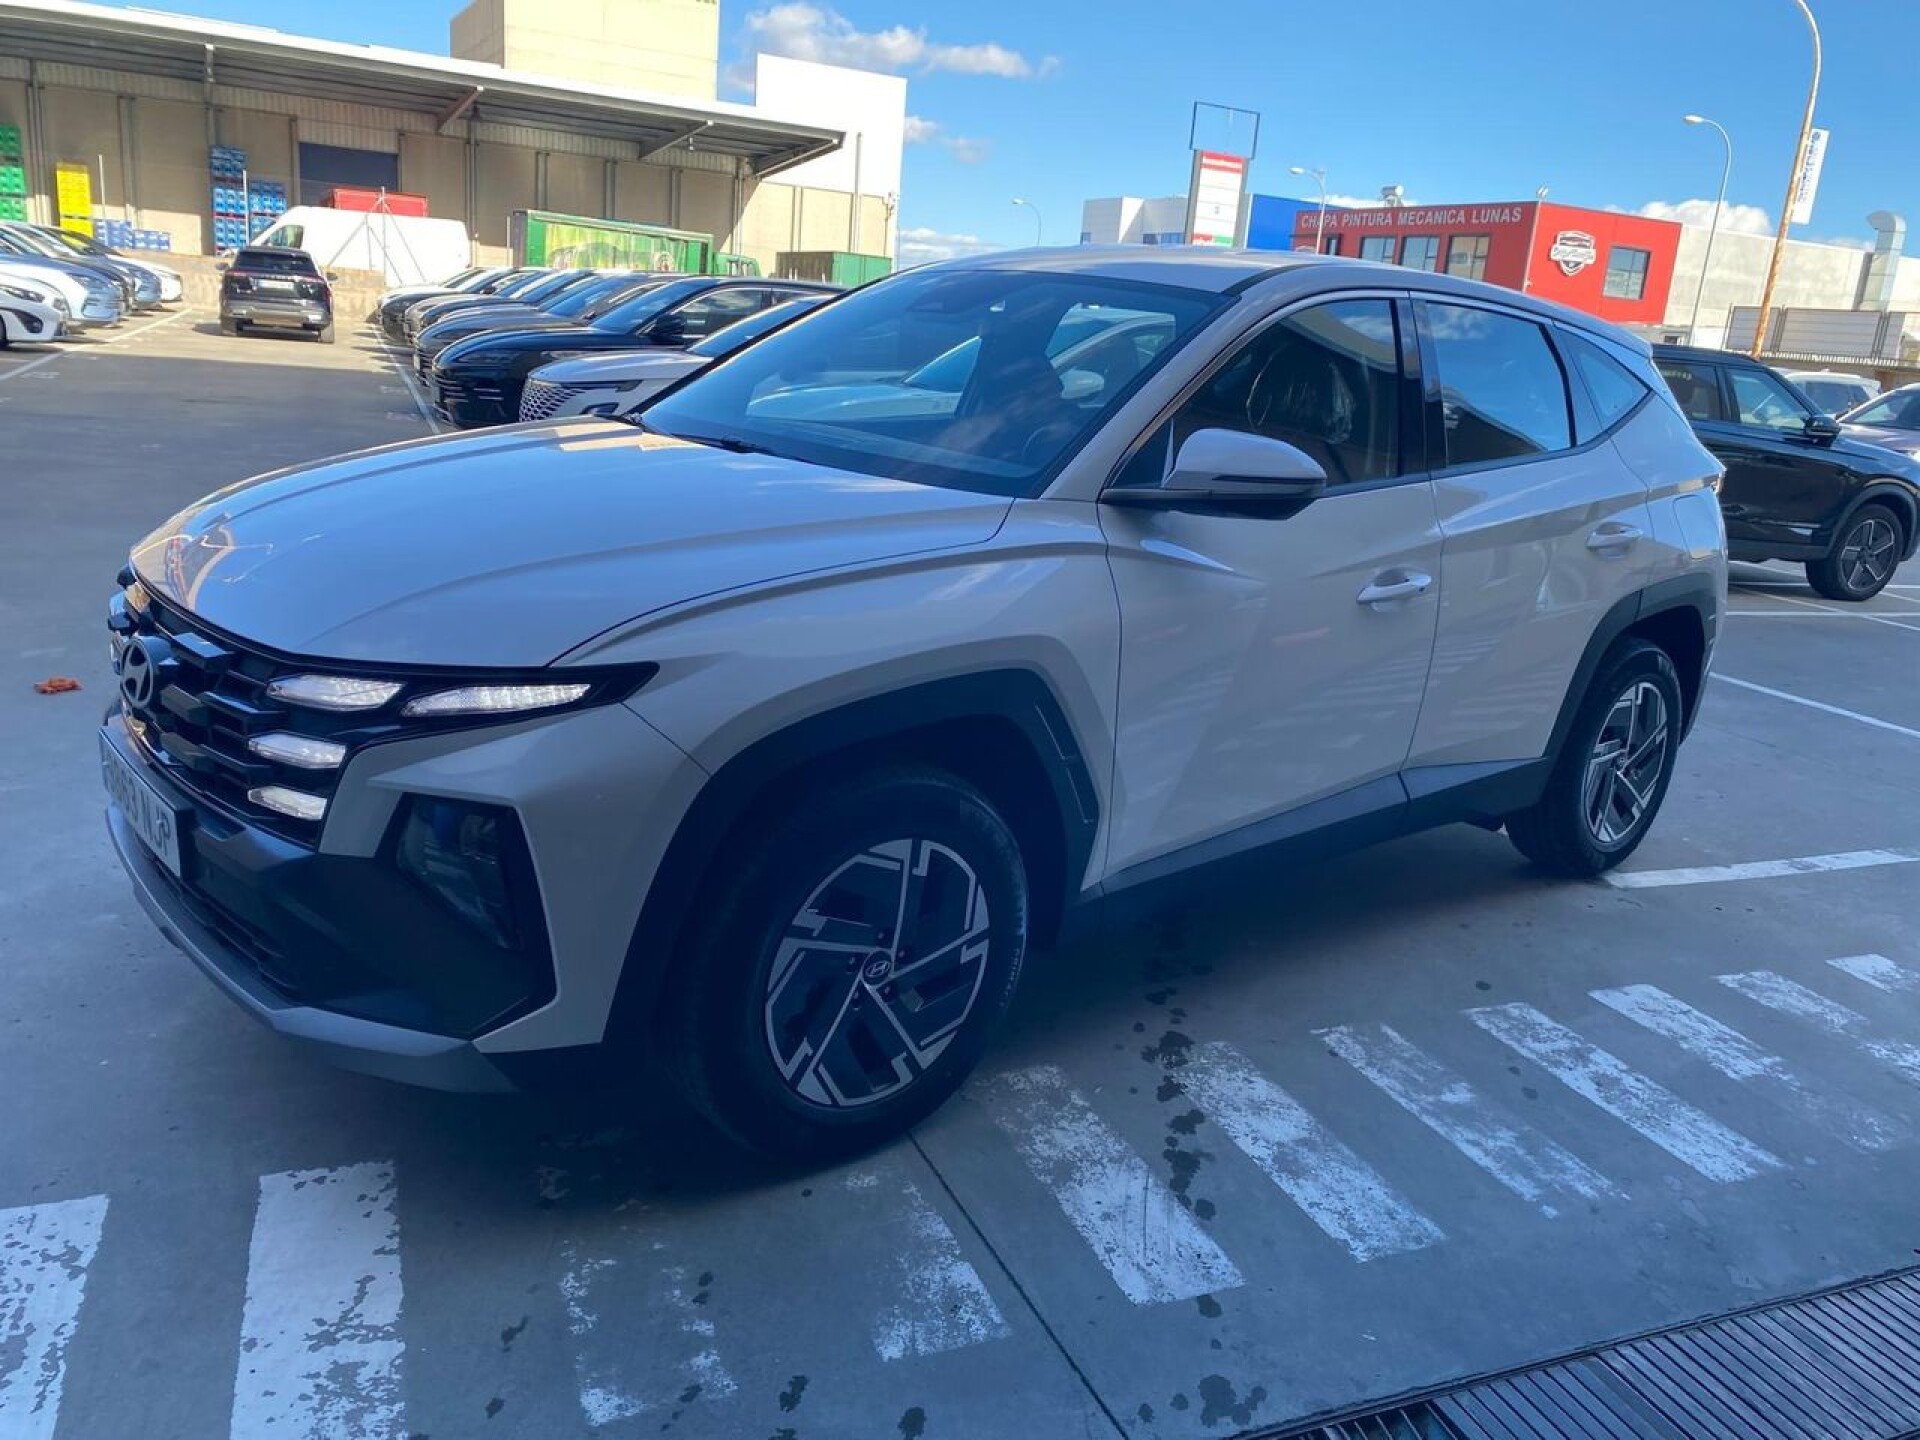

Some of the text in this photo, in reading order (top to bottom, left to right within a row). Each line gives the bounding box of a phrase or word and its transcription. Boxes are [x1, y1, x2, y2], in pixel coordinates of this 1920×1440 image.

[1343, 212, 1393, 227] PINTURA
[1397, 209, 1465, 226] MECANICA
[1472, 206, 1522, 223] LUNAS
